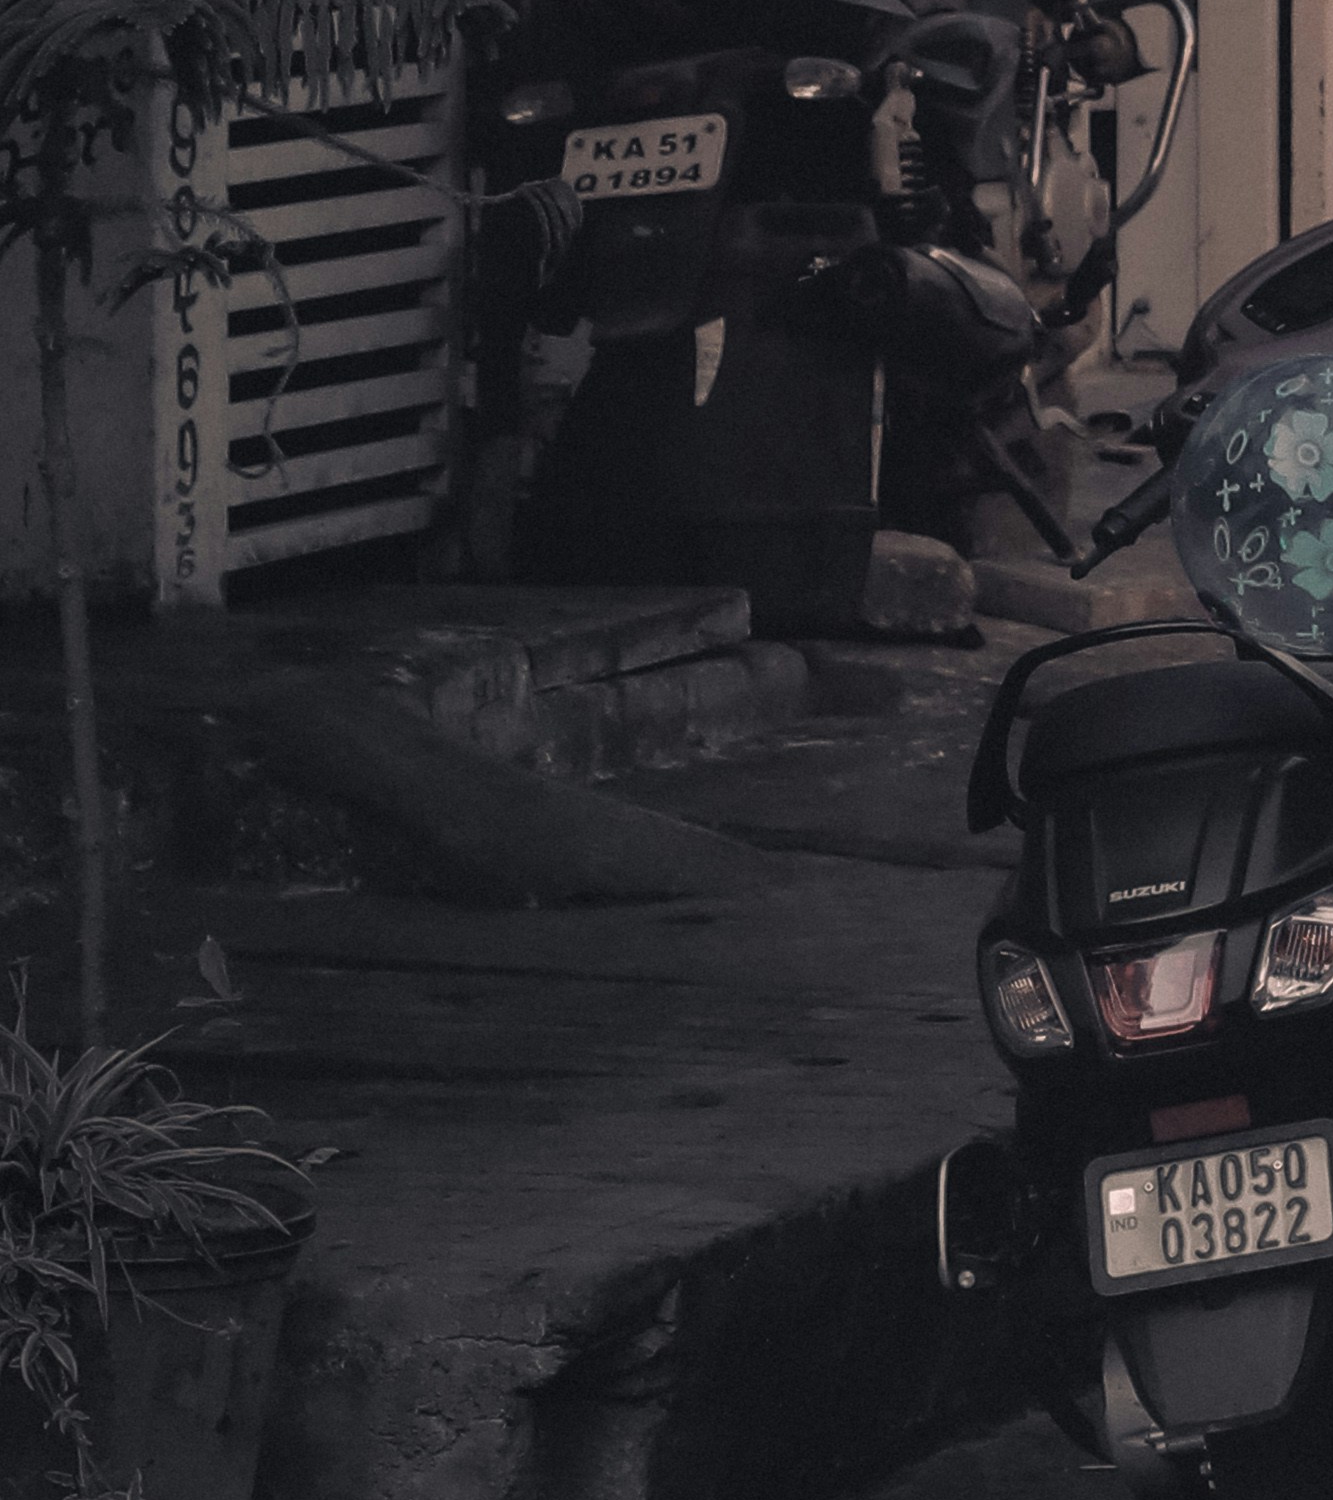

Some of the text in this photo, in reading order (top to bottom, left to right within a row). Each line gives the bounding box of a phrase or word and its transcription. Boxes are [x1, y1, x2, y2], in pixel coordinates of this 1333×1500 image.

[593, 133, 697, 160] KA 51
[1108, 880, 1186, 903] SUZUKI
[1110, 1216, 1138, 1233] IND
